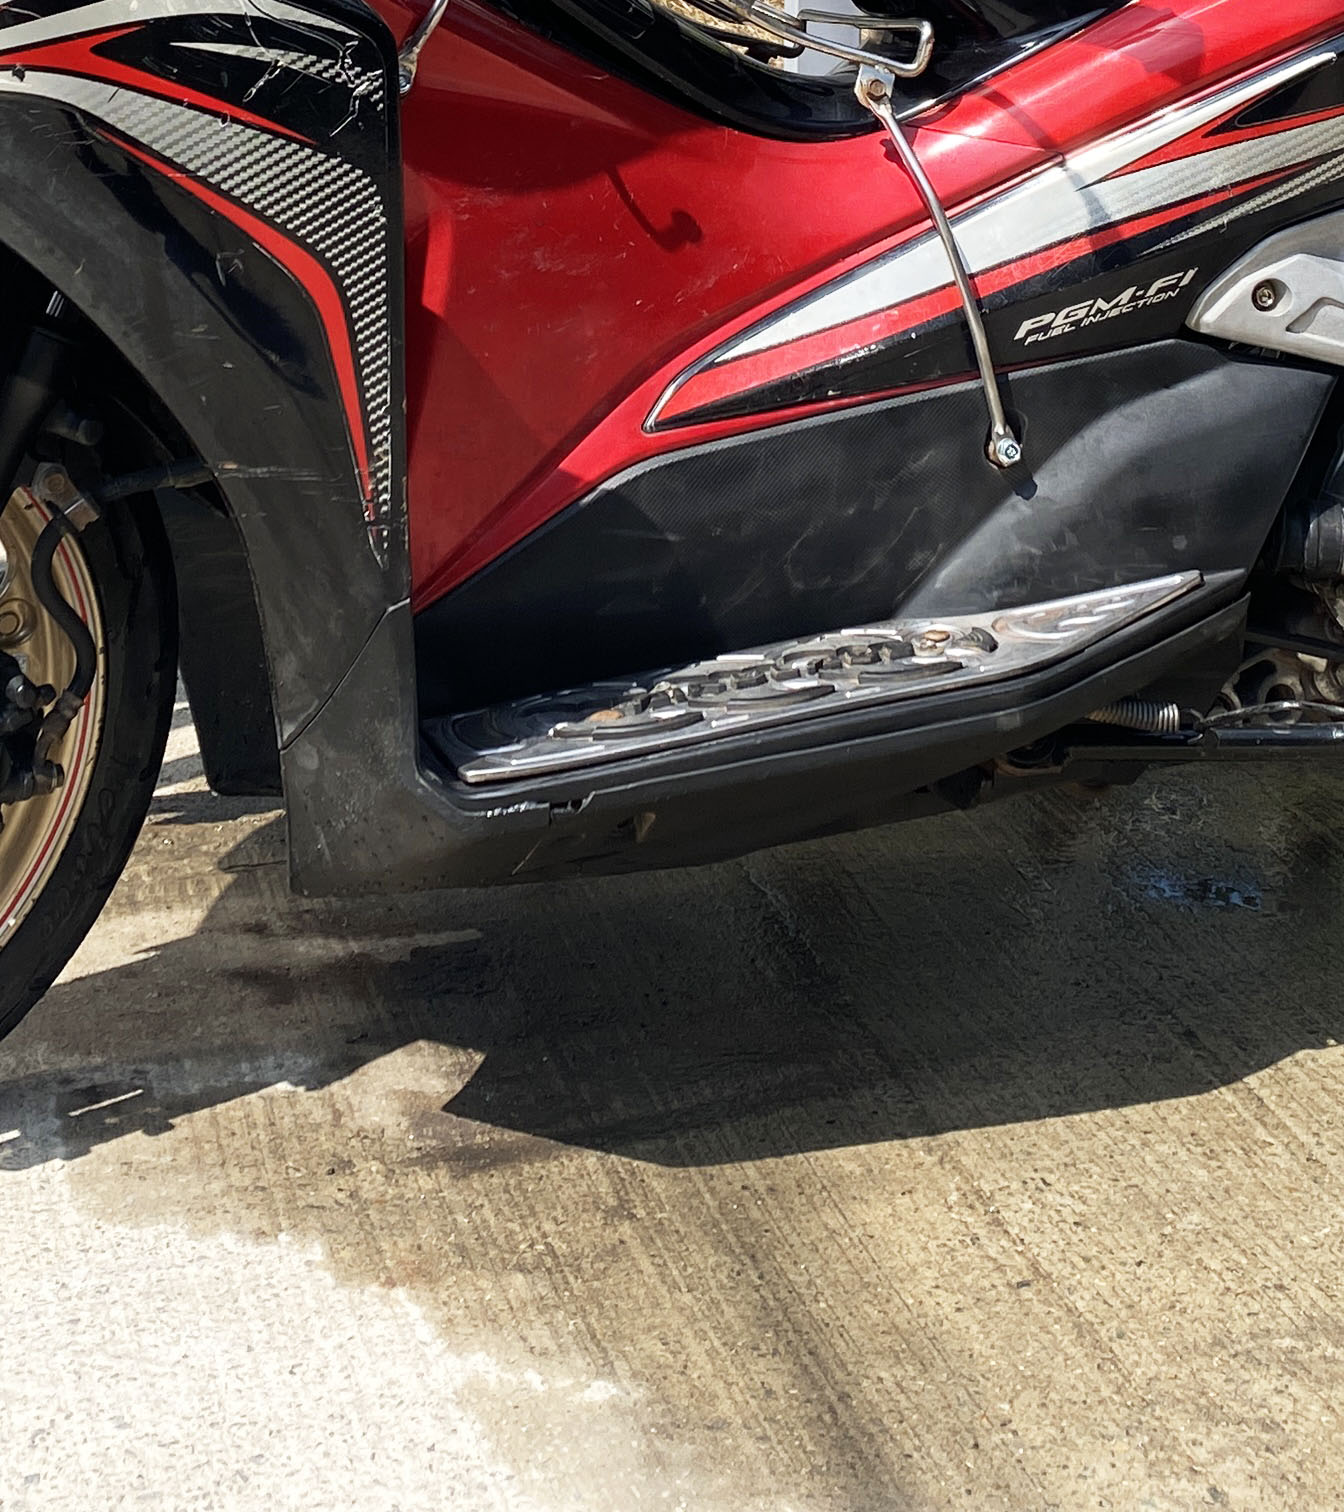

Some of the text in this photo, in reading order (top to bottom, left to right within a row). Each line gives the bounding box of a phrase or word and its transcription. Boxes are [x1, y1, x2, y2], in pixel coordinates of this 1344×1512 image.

[1013, 266, 1199, 342] PGM-FI
[1023, 287, 1181, 347] FUEL INJECTION
